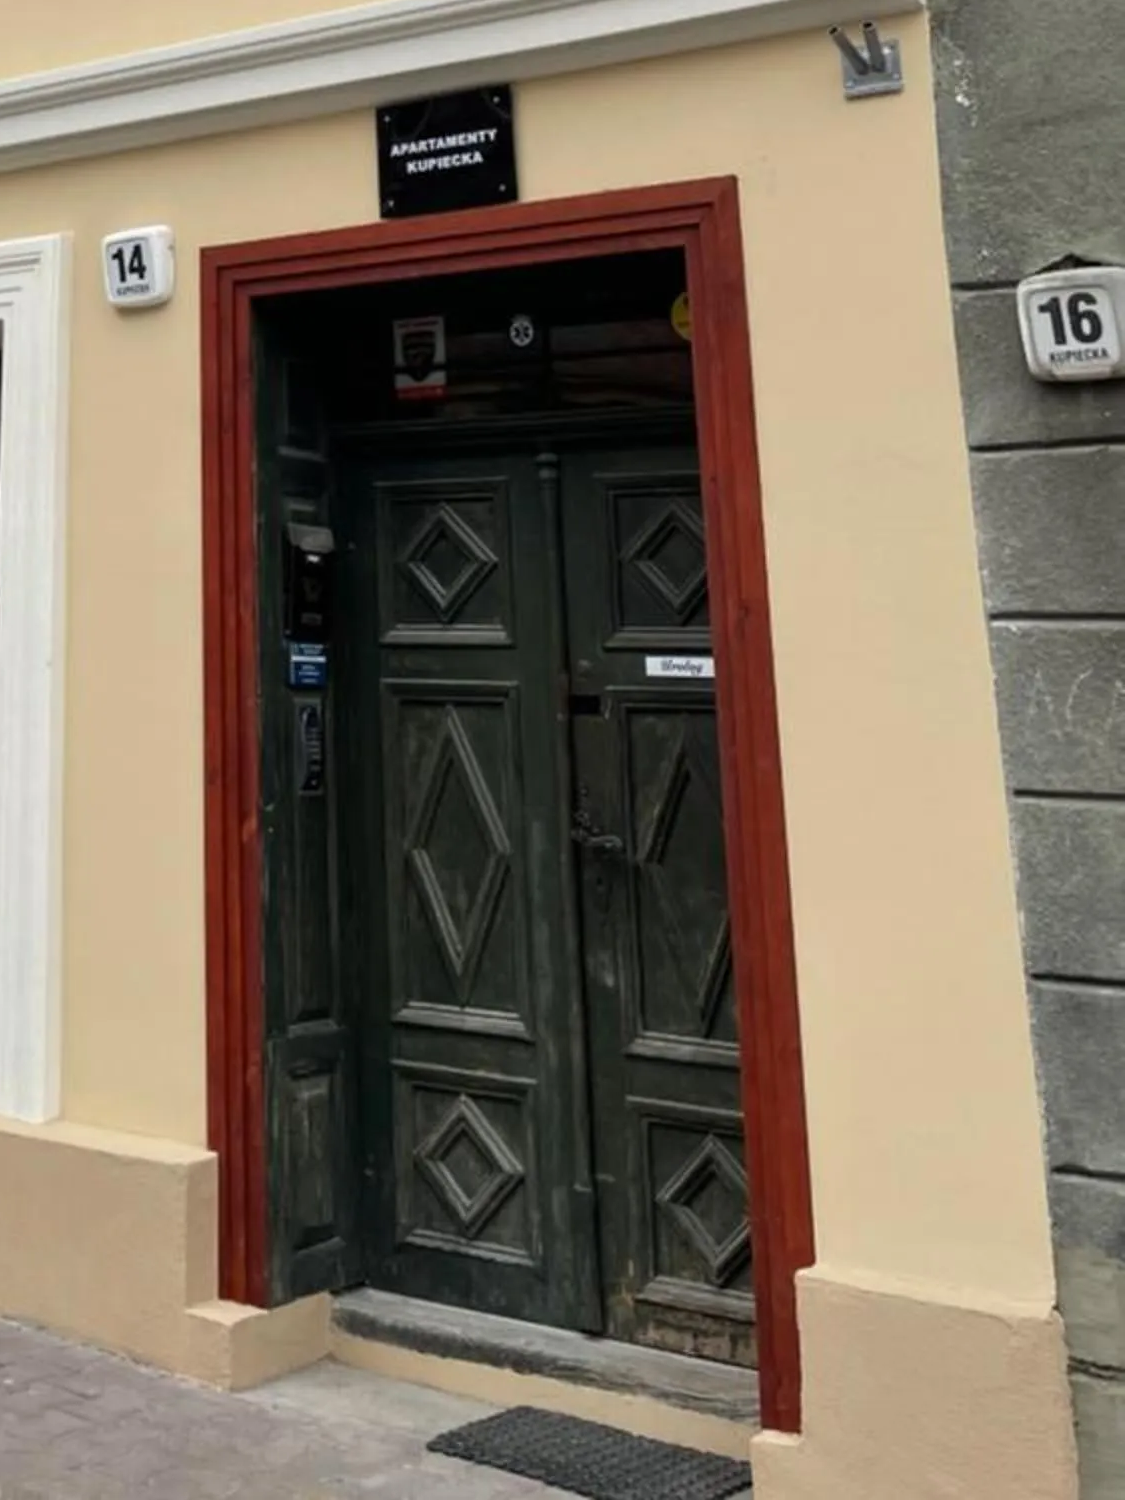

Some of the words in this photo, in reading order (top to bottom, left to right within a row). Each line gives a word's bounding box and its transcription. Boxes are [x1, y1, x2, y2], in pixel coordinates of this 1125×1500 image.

[390, 128, 498, 157] APARTAMENTY
[406, 151, 484, 175] KUPIECKA
[111, 243, 147, 283] 14
[1037, 291, 1103, 346] 16
